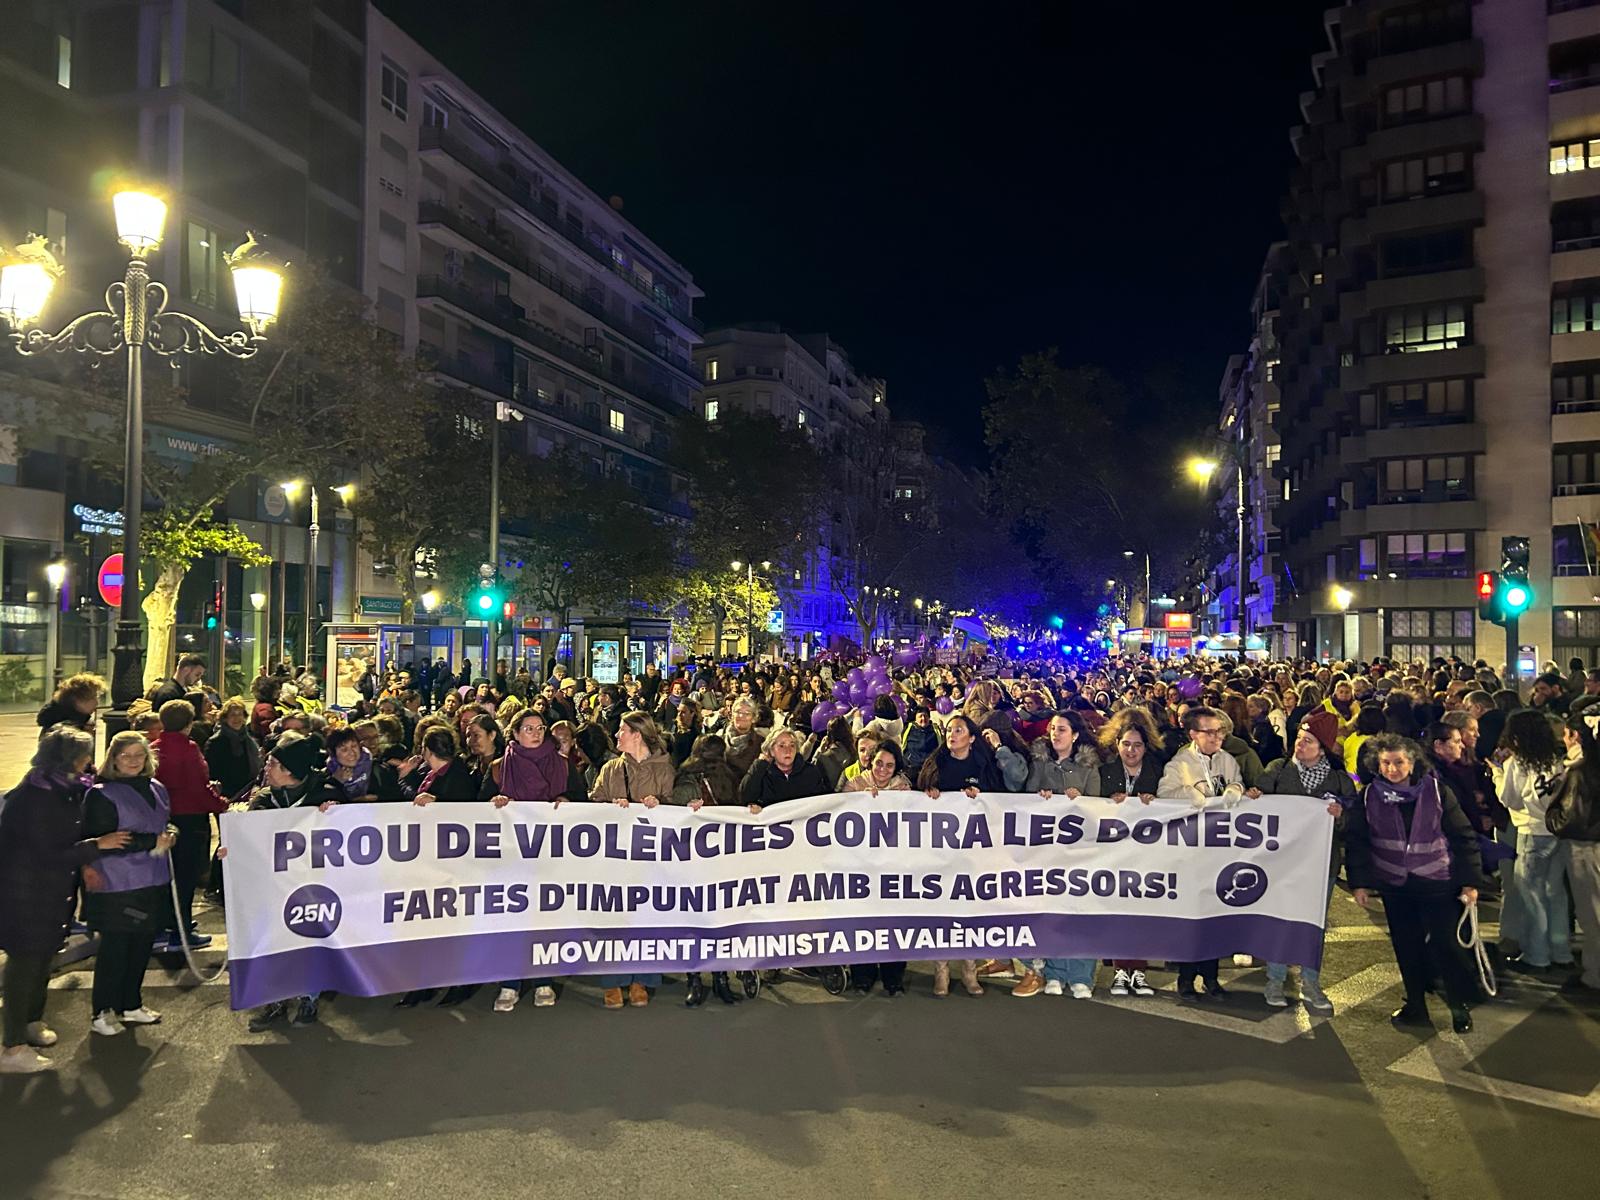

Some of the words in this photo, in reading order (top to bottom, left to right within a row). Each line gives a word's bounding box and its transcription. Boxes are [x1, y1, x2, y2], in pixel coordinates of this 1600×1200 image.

[274, 824, 420, 872] PROU
[438, 824, 501, 859] DE
[514, 817, 795, 861] VIOLÈNCIES
[806, 812, 993, 849] CONTRA
[1004, 813, 1084, 846] LES
[1096, 812, 1280, 851] DONES!
[289, 902, 337, 925] 25N
[384, 884, 529, 923] FARTES
[540, 876, 781, 912] D'IMPUNITAT
[788, 873, 870, 902] AMB
[880, 874, 942, 899] ELS
[950, 869, 1178, 900] AGRESSORS!
[532, 938, 696, 966] MOVIMENT
[700, 931, 850, 960] FEMINISTA
[855, 929, 889, 951] DE
[893, 921, 1037, 949] VALÈNCIA
